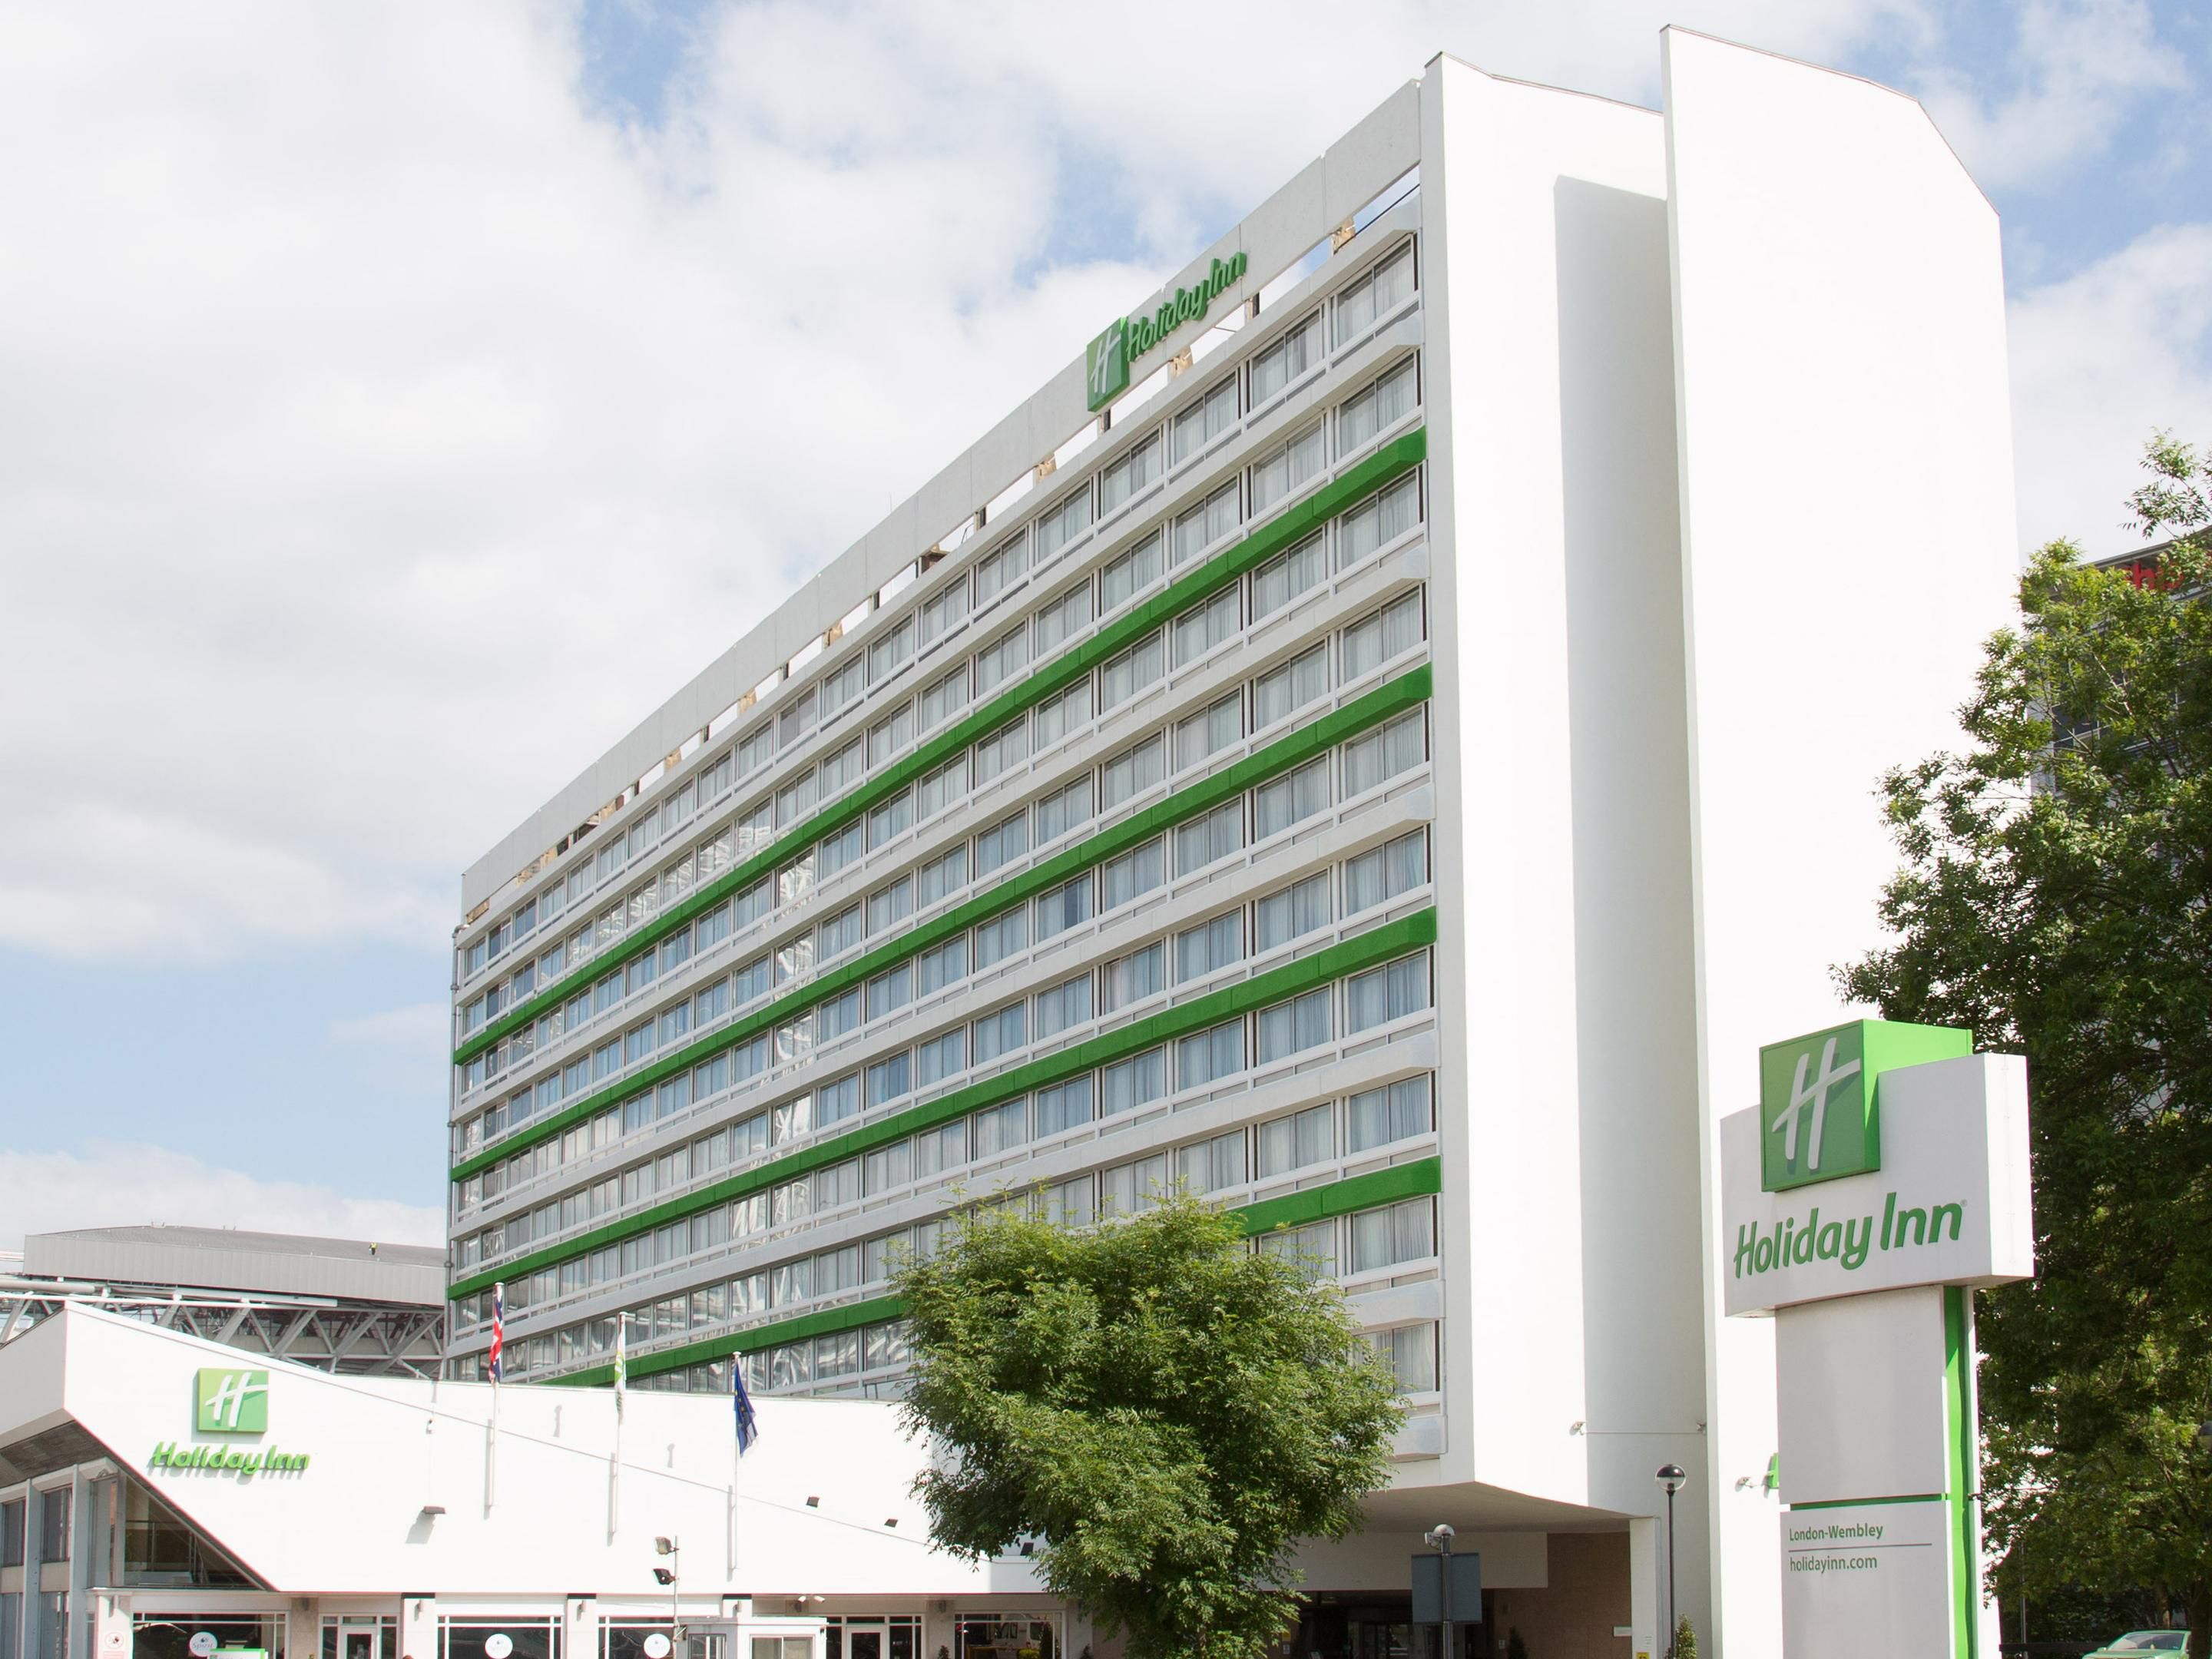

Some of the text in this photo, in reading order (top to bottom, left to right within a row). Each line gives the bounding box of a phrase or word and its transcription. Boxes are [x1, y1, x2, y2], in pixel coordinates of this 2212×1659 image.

[1126, 252, 1247, 362] Holiday Inn
[1734, 1192, 1963, 1279] Holiday Inn
[154, 1442, 310, 1475] Holiday Inn
[1789, 1523, 1883, 1541] London-Wembley
[1790, 1555, 1878, 1574] holidayinn.com
